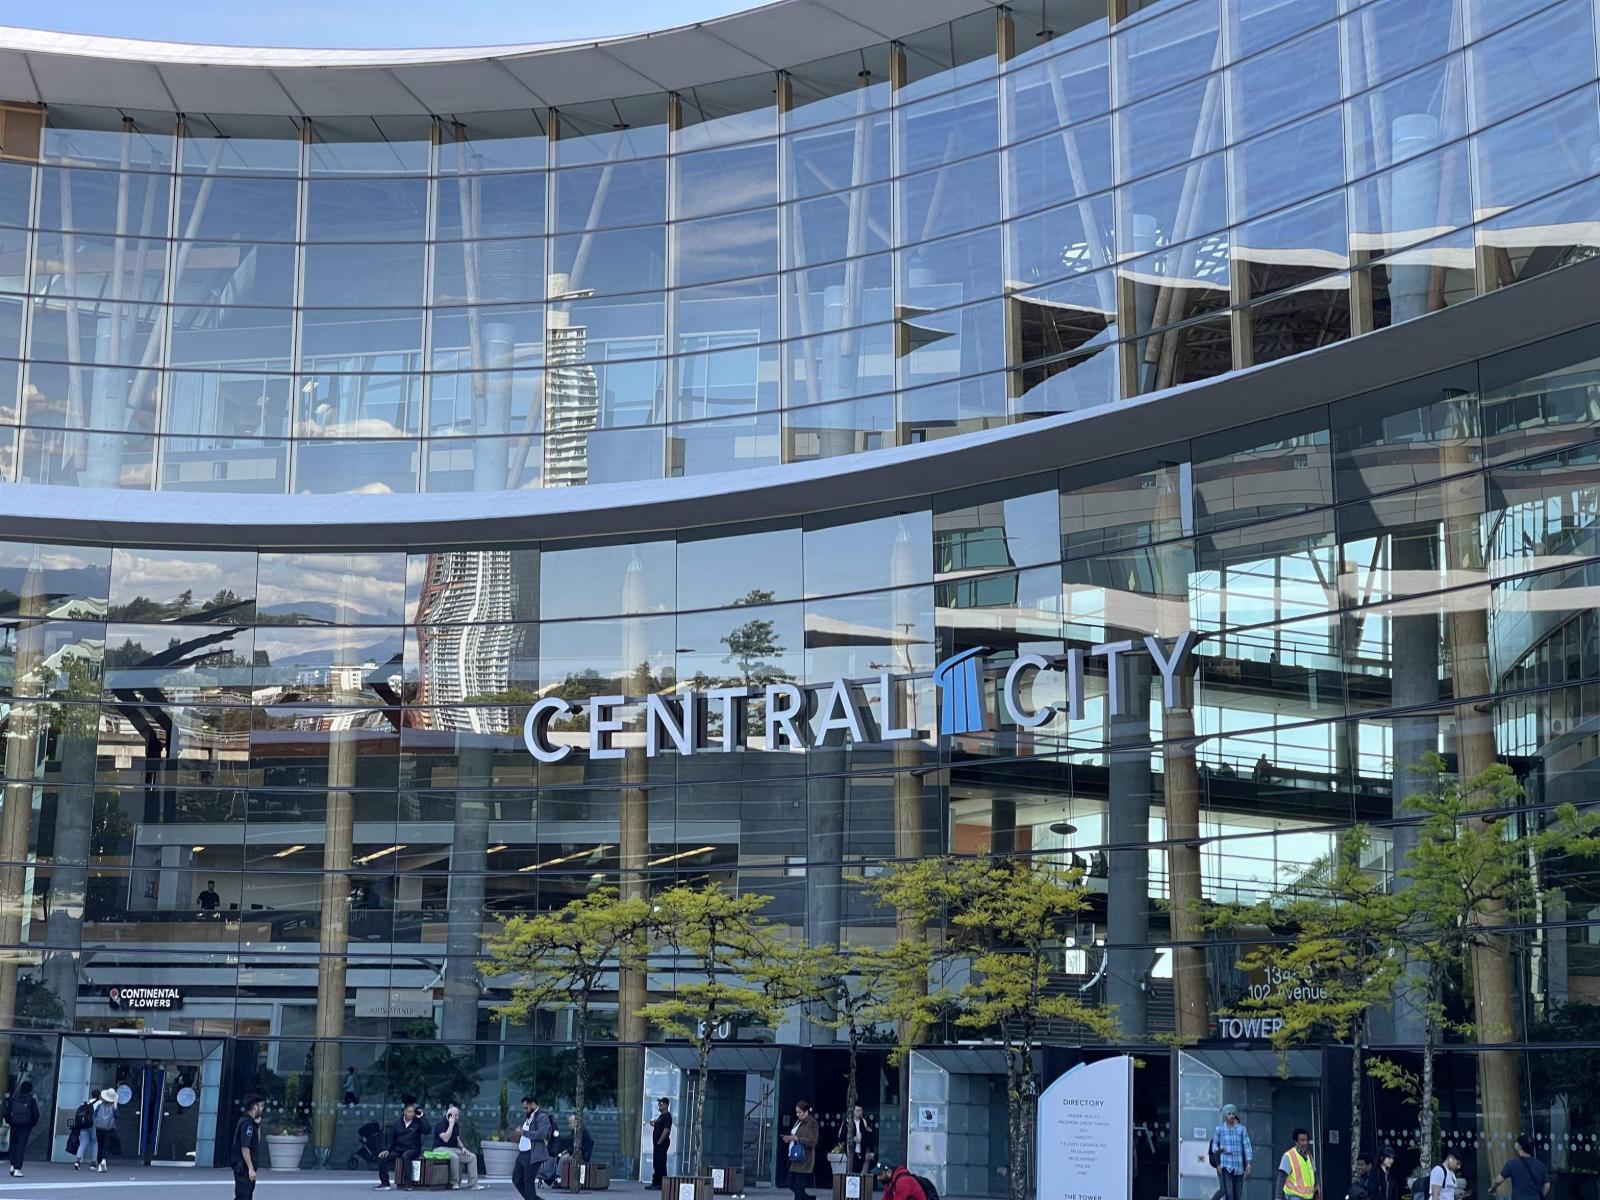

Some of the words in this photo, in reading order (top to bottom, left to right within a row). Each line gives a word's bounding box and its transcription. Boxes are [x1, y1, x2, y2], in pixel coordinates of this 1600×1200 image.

[523, 672, 918, 763] CENTRAL
[1004, 631, 1197, 727] CITY
[120, 988, 180, 999] CONTINENTAL
[1248, 984, 1271, 1000] 102
[129, 999, 171, 1008] FLOWERS
[1063, 1098, 1105, 1107] DIRECTORY
